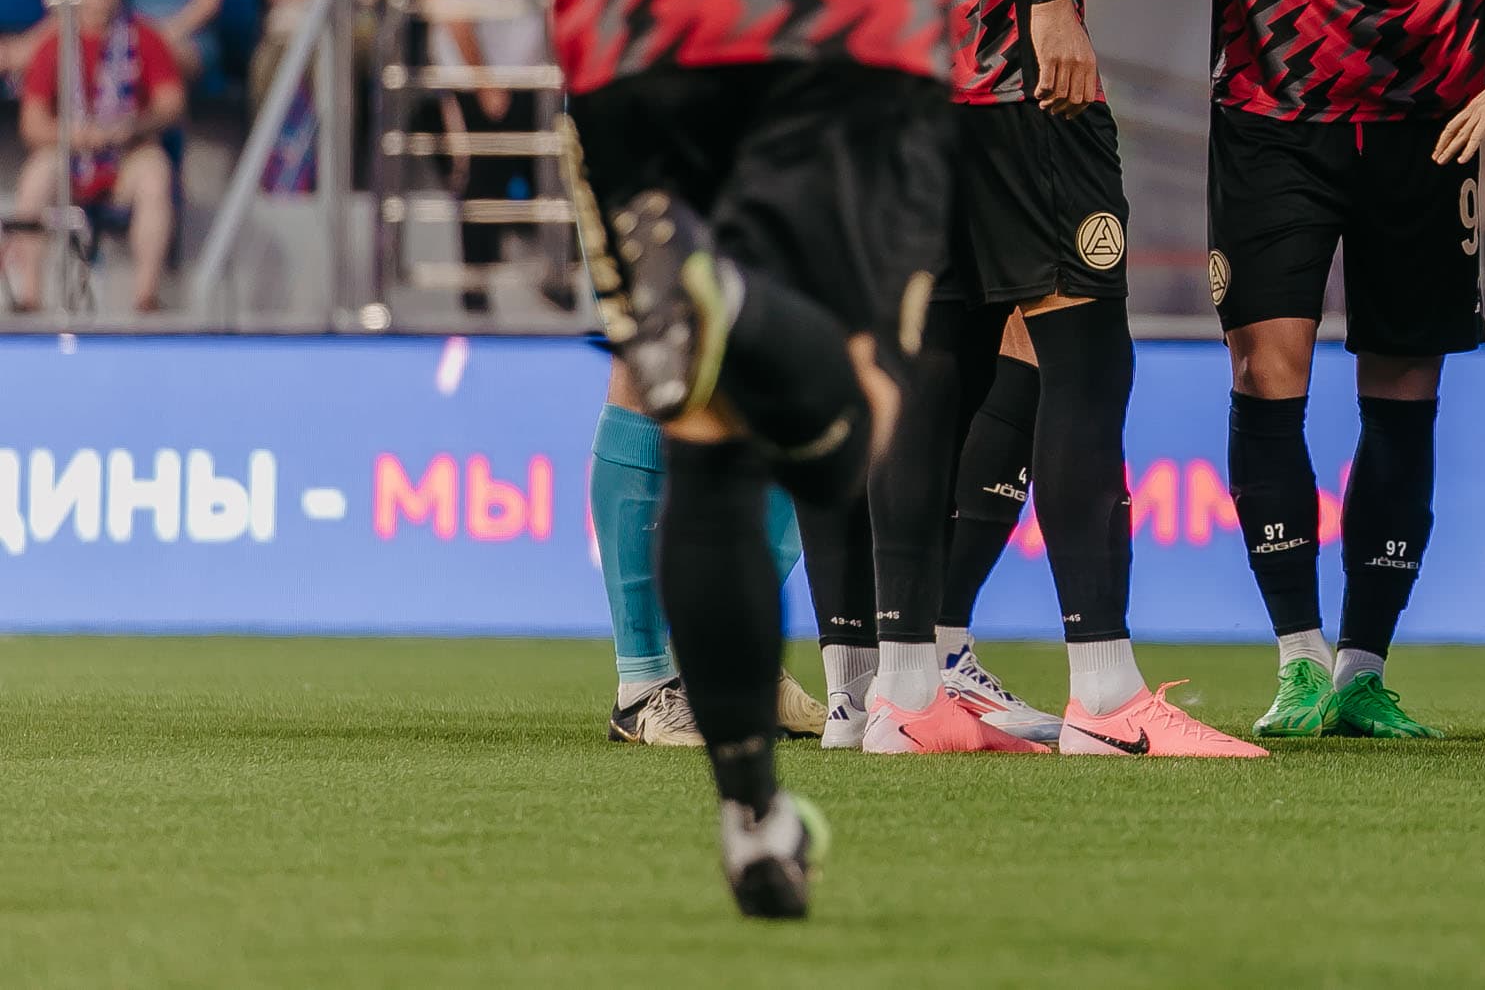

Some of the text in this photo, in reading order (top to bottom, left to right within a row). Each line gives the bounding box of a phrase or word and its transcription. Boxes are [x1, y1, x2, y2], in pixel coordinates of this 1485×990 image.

[0, 448, 276, 555] ИНЫ
[374, 451, 554, 542] МЫ
[1264, 522, 1285, 541] 97
[1251, 537, 1311, 554] JÖGEL
[1386, 540, 1407, 557] 97
